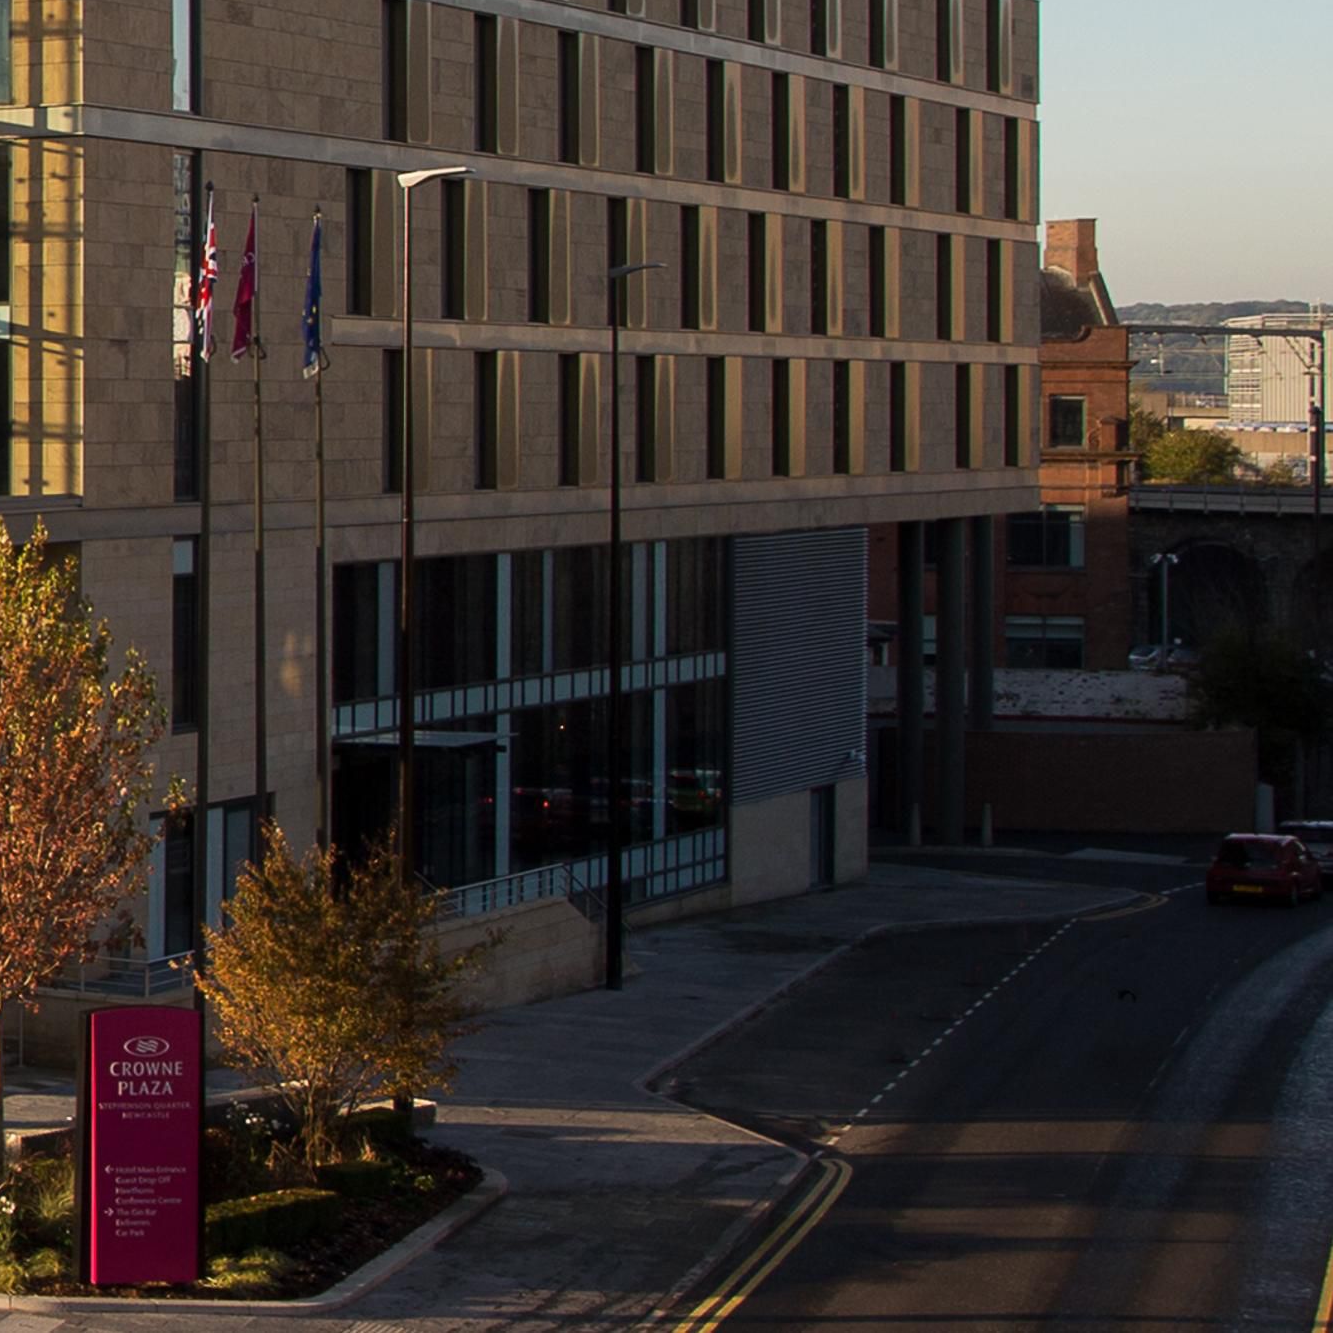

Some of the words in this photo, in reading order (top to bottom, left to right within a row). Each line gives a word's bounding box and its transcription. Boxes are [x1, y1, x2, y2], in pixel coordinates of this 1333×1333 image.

[110, 1061, 183, 1077] CROWNE
[118, 1081, 173, 1096] PLAZA
[98, 1102, 152, 1110] STEPHENSON
[122, 1111, 170, 1119] NEWCASTLE
[156, 1166, 187, 1174] Entrance
[115, 1176, 137, 1184] Guest
[115, 1197, 157, 1205] Conference
[157, 1197, 182, 1205] Centre
